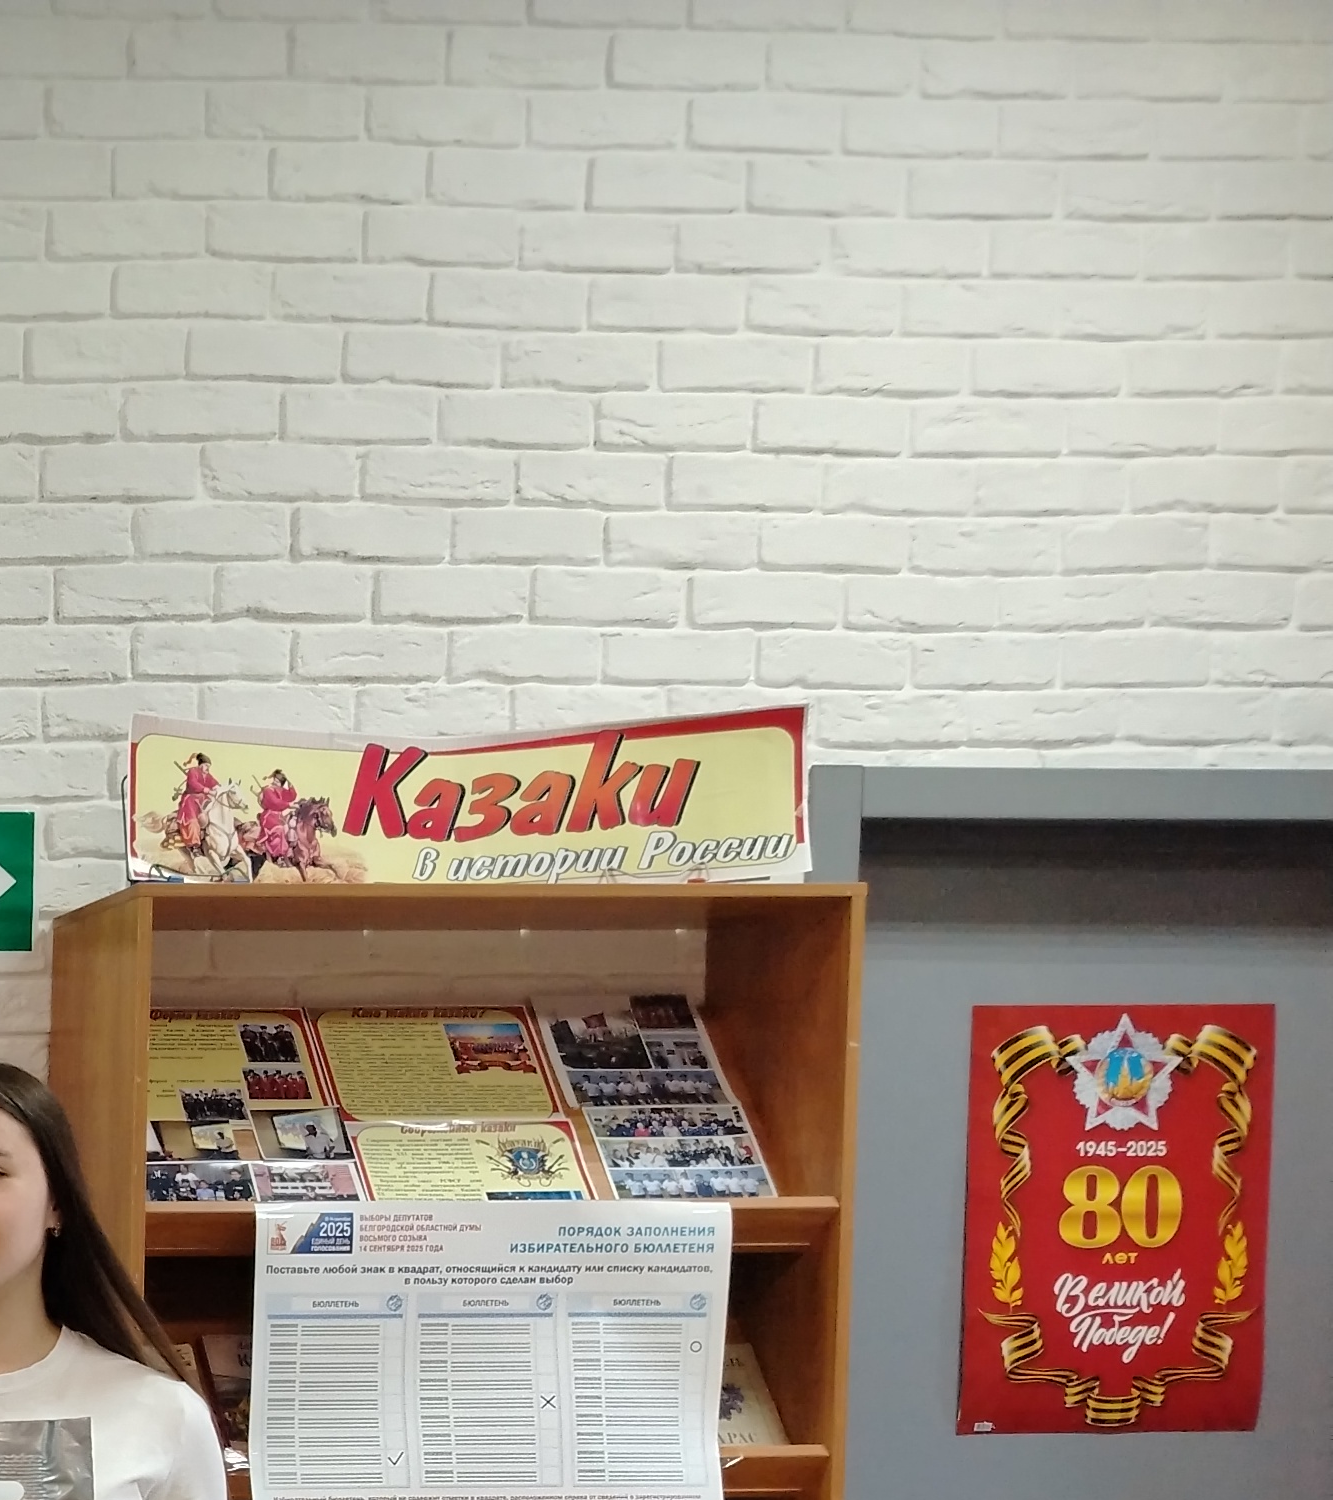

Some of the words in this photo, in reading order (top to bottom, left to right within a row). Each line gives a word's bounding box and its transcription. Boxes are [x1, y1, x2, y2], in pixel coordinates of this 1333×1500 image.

[341, 730, 701, 844] Казаки
[412, 848, 436, 883] в
[447, 842, 627, 888] истории
[637, 828, 799, 874] России
[1059, 1164, 1183, 1250] 80
[359, 1214, 392, 1222] ВЫБОРЫ
[392, 1213, 433, 1222] ДЕПУТАТОВ
[319, 1222, 351, 1237] 2025
[359, 1223, 415, 1233] БЕЛГОРОДСКОЙ
[415, 1223, 458, 1232] ОБЛАСТНОЙ
[459, 1223, 482, 1233] ДУМЫ
[558, 1226, 622, 1238] ПОРЯДОК
[626, 1226, 716, 1237] ЗАПОЛНЕНИЯ
[310, 1237, 335, 1246] ЕДИНЫЙ
[335, 1237, 351, 1245] ДЕНЬ
[359, 1234, 397, 1242] ВОСЬМОГО
[398, 1234, 428, 1242] СОЗЫВА
[369, 1244, 405, 1253] СЕНТЯБРЯ
[406, 1244, 424, 1252] 2025
[425, 1244, 444, 1253] ГОДА
[509, 1242, 629, 1254] ИЗБИРАТЕЛЬНОГО
[634, 1242, 715, 1254] БЮЛЛЕТЕНЯ
[265, 1264, 320, 1275] Поставьте
[322, 1263, 358, 1274] любой
[360, 1265, 386, 1274] знак
[397, 1265, 443, 1277] квадрат,
[445, 1263, 516, 1276] относящийся
[527, 1264, 582, 1275] кандидату
[584, 1264, 604, 1274] или
[606, 1265, 645, 1275] списку
[647, 1264, 714, 1275] кандидатов,
[413, 1276, 448, 1287] пользу
[450, 1275, 498, 1287] которого
[499, 1275, 537, 1286] сделан
[538, 1274, 574, 1287] выбор
[1053, 1268, 1187, 1320] Великой
[312, 1299, 360, 1309] БЮЛЛЕТЕНЬ
[462, 1299, 509, 1308] БЮЛЛЕТЕНЬ
[613, 1298, 662, 1308] БЮЛЛЕТЕНЬ
[1068, 1311, 1176, 1364] Победе!
